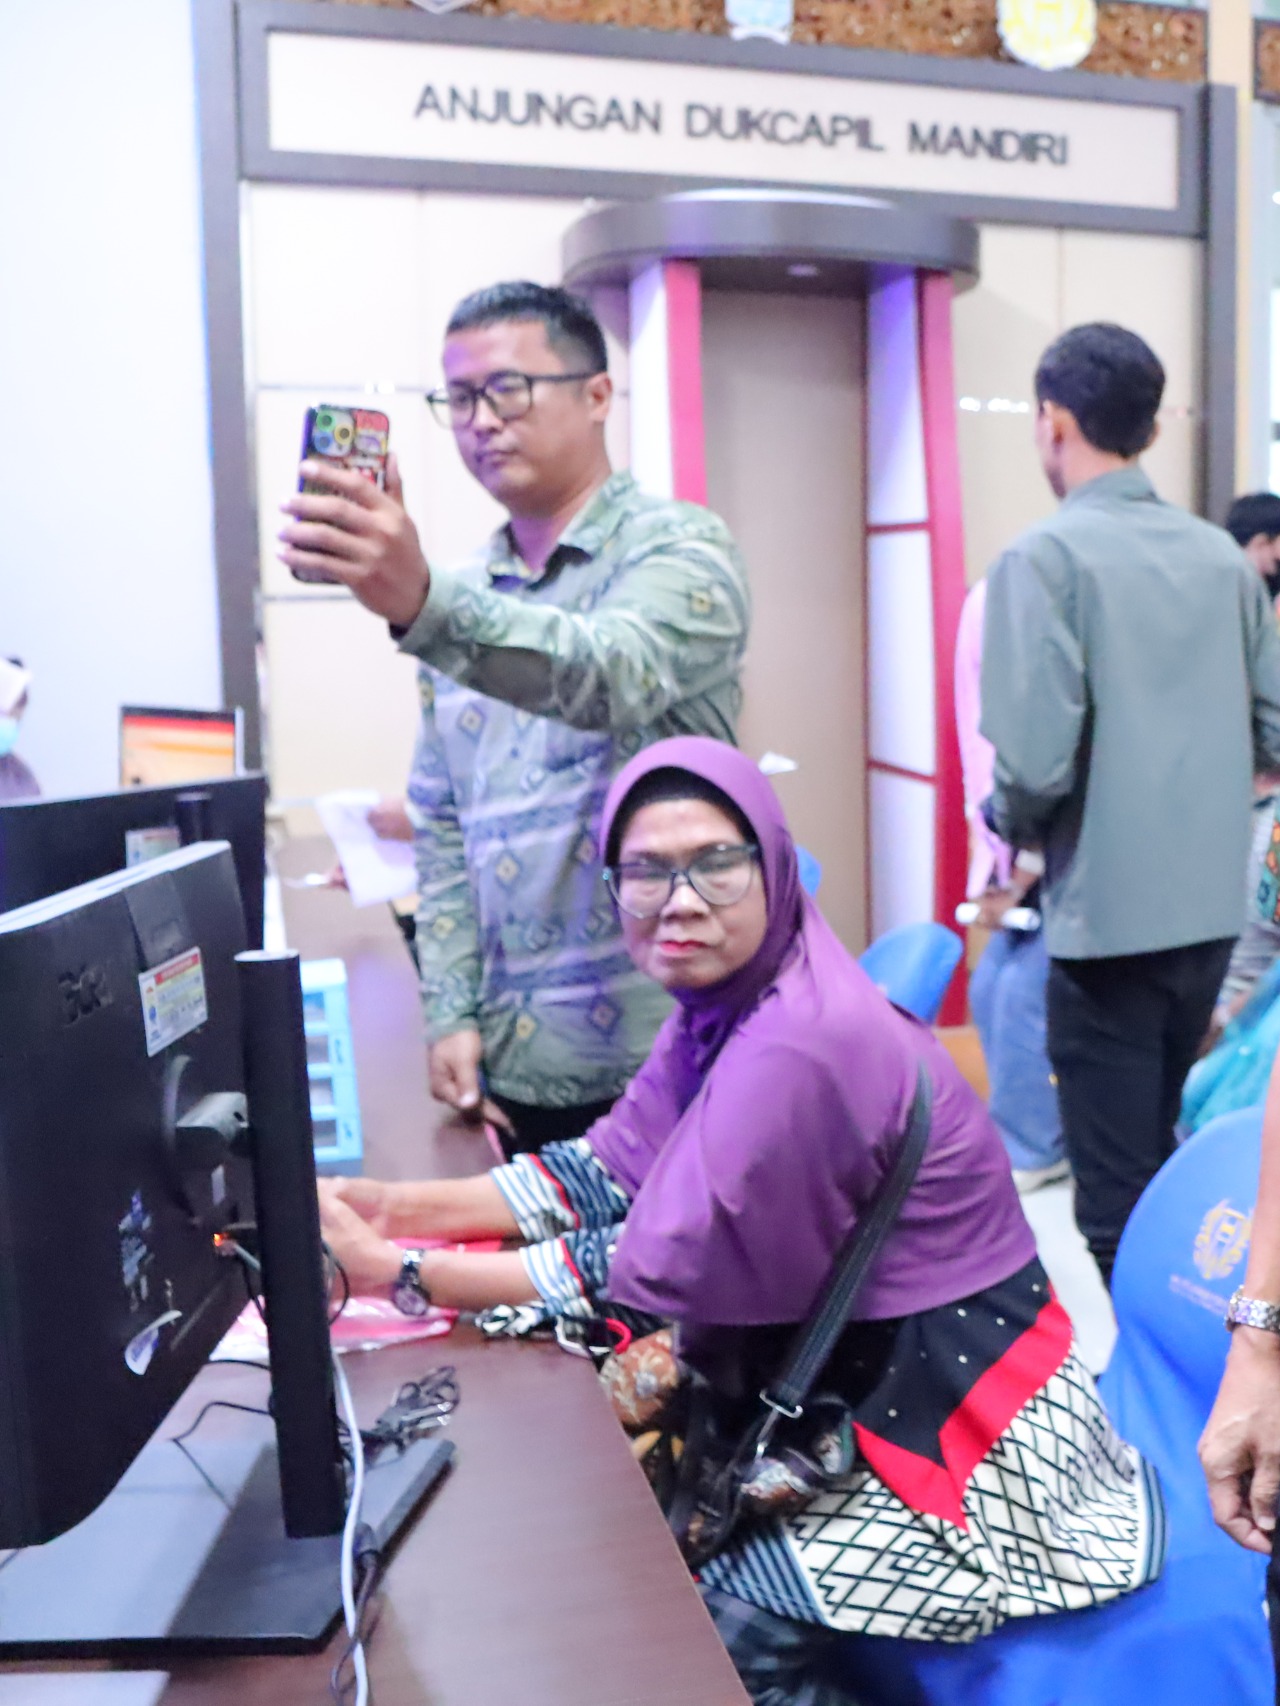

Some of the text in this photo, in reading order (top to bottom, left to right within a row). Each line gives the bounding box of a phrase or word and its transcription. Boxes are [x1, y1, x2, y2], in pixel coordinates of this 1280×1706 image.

[413, 83, 1069, 166] ANJUNGAN DUKCAPIL MANDIRI
